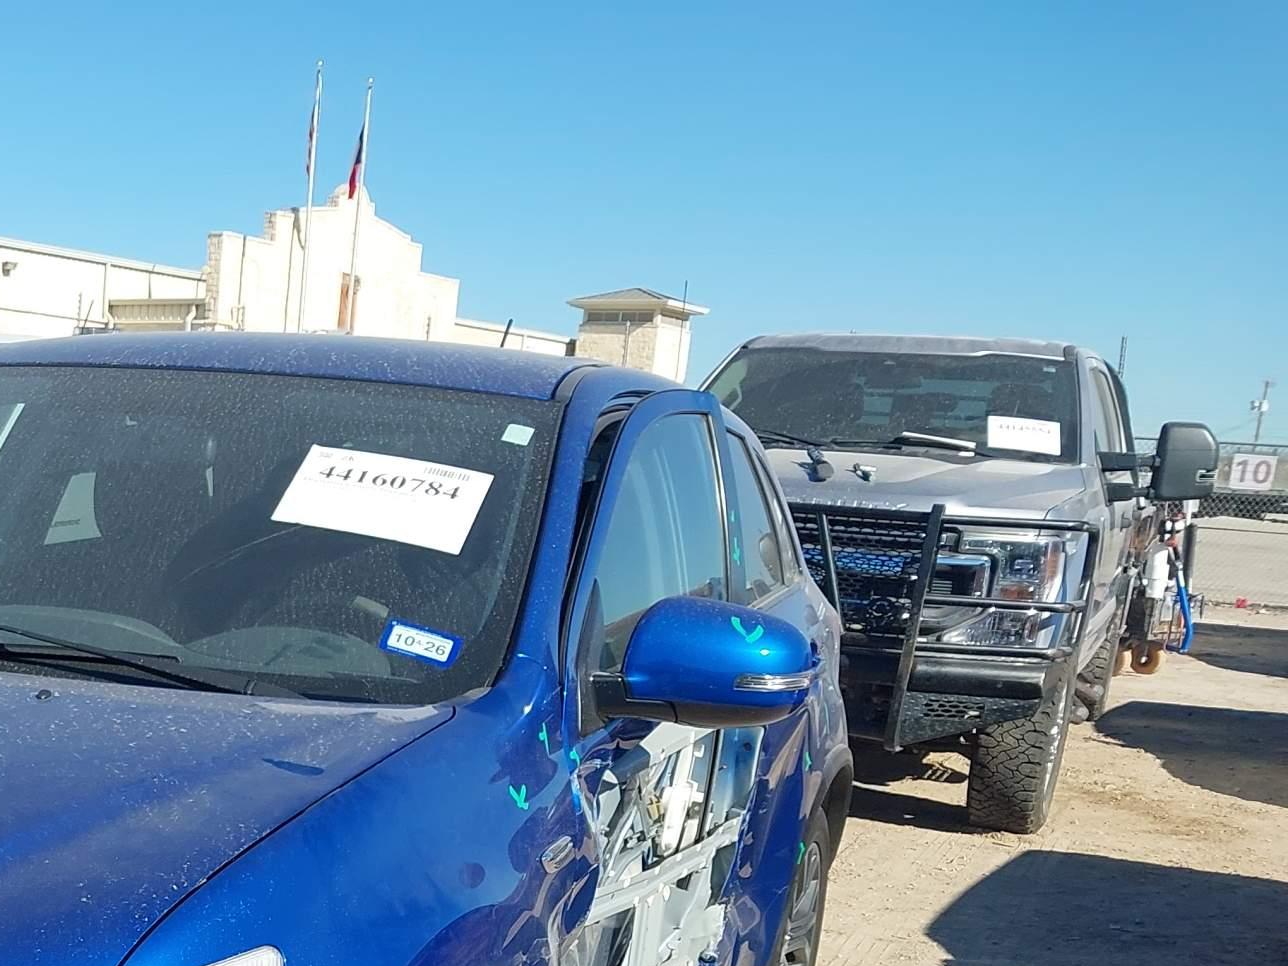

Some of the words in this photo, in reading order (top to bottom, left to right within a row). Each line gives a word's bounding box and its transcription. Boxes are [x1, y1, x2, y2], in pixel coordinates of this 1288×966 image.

[319, 465, 461, 500] 44160784
[1235, 459, 1272, 484] 10
[395, 633, 416, 647] 10
[424, 641, 446, 656] 26
